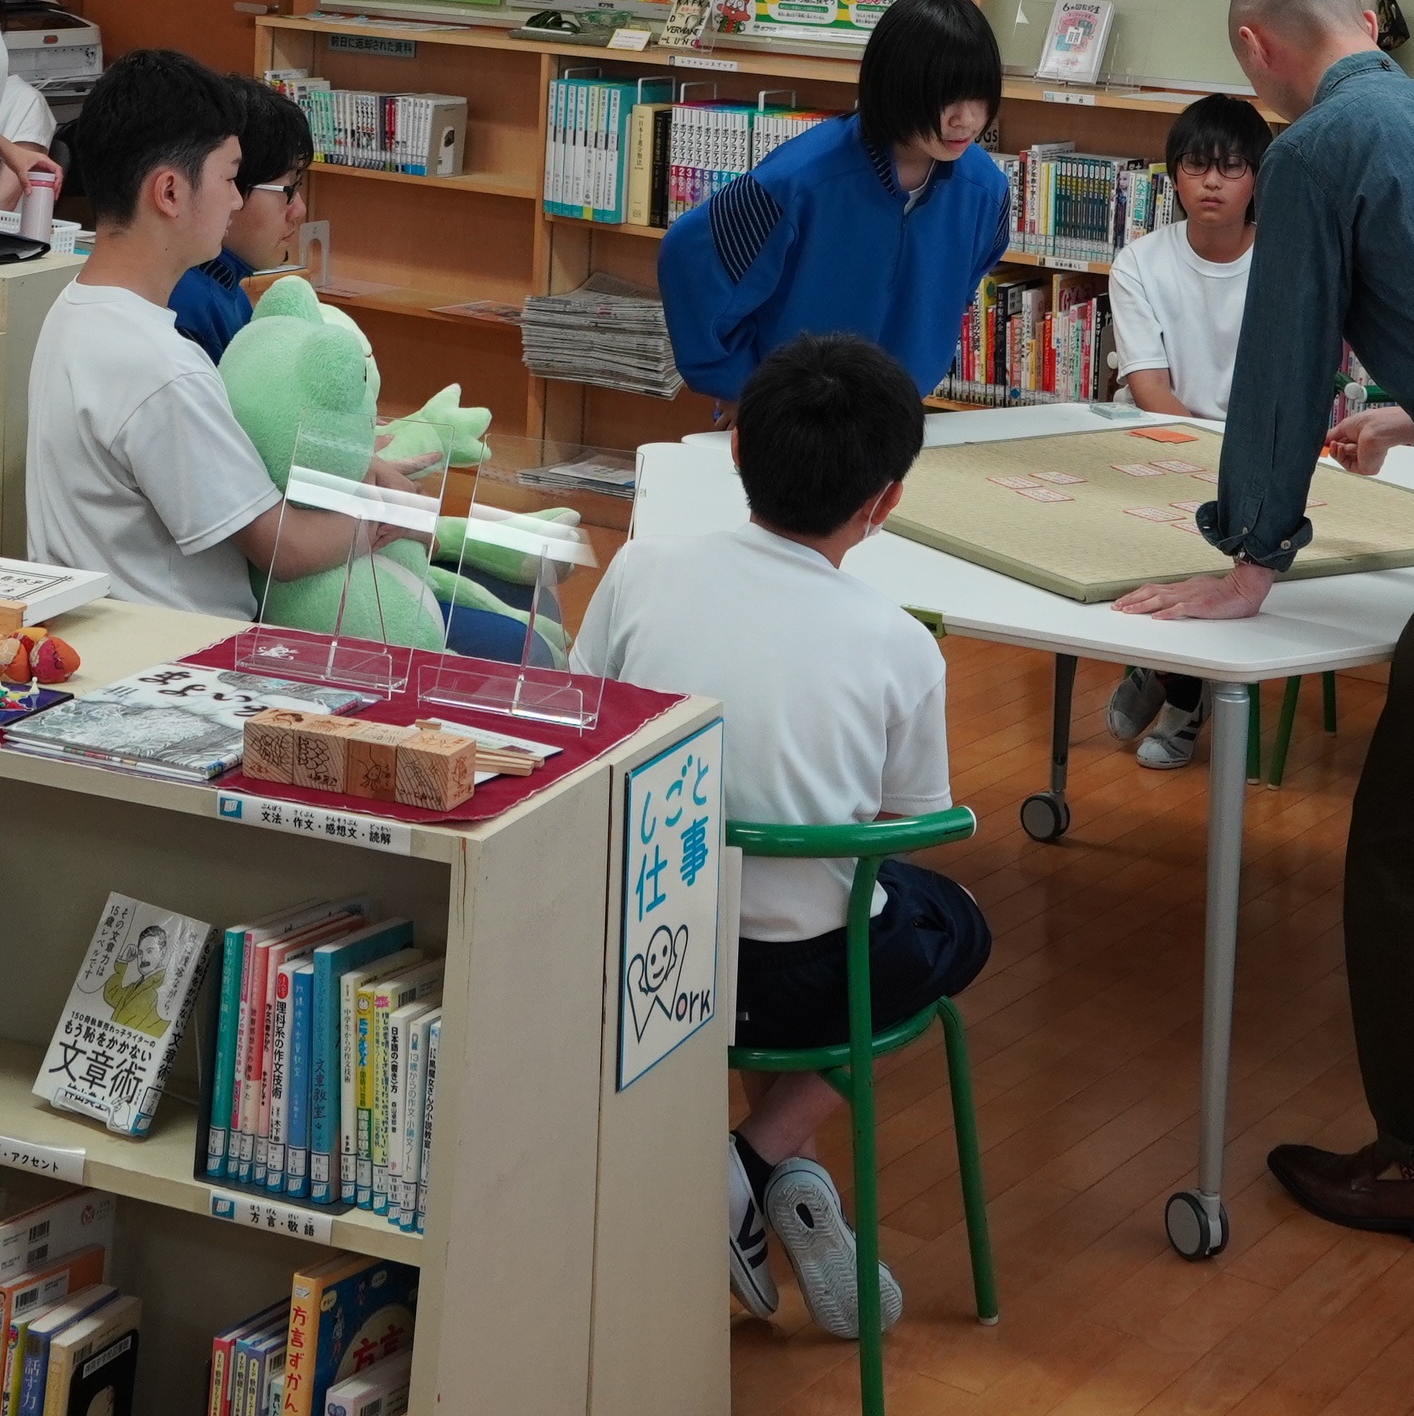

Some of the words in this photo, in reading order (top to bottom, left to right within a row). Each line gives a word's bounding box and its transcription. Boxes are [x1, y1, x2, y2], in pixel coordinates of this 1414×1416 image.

[260, 811, 392, 845] 文法・作文・感想文・読解
[640, 754, 709, 845] しごと
[634, 815, 709, 923] 仕事
[84, 905, 120, 980] 15歳レベルです
[96, 907, 129, 977] その文章力は
[48, 1039, 147, 1104] 文章術
[64, 1019, 152, 1062] もう恥をかかない
[272, 1001, 288, 1100] 理科系の作文技術
[343, 1007, 351, 1084] 中学生からの作文技術
[314, 1059, 328, 1119] 文章教室
[250, 1212, 314, 1237] 方言・敬語
[284, 1306, 307, 1413] 方言ずかん
[353, 1324, 405, 1372] 方言
[23, 1358, 42, 1409] 話す力
